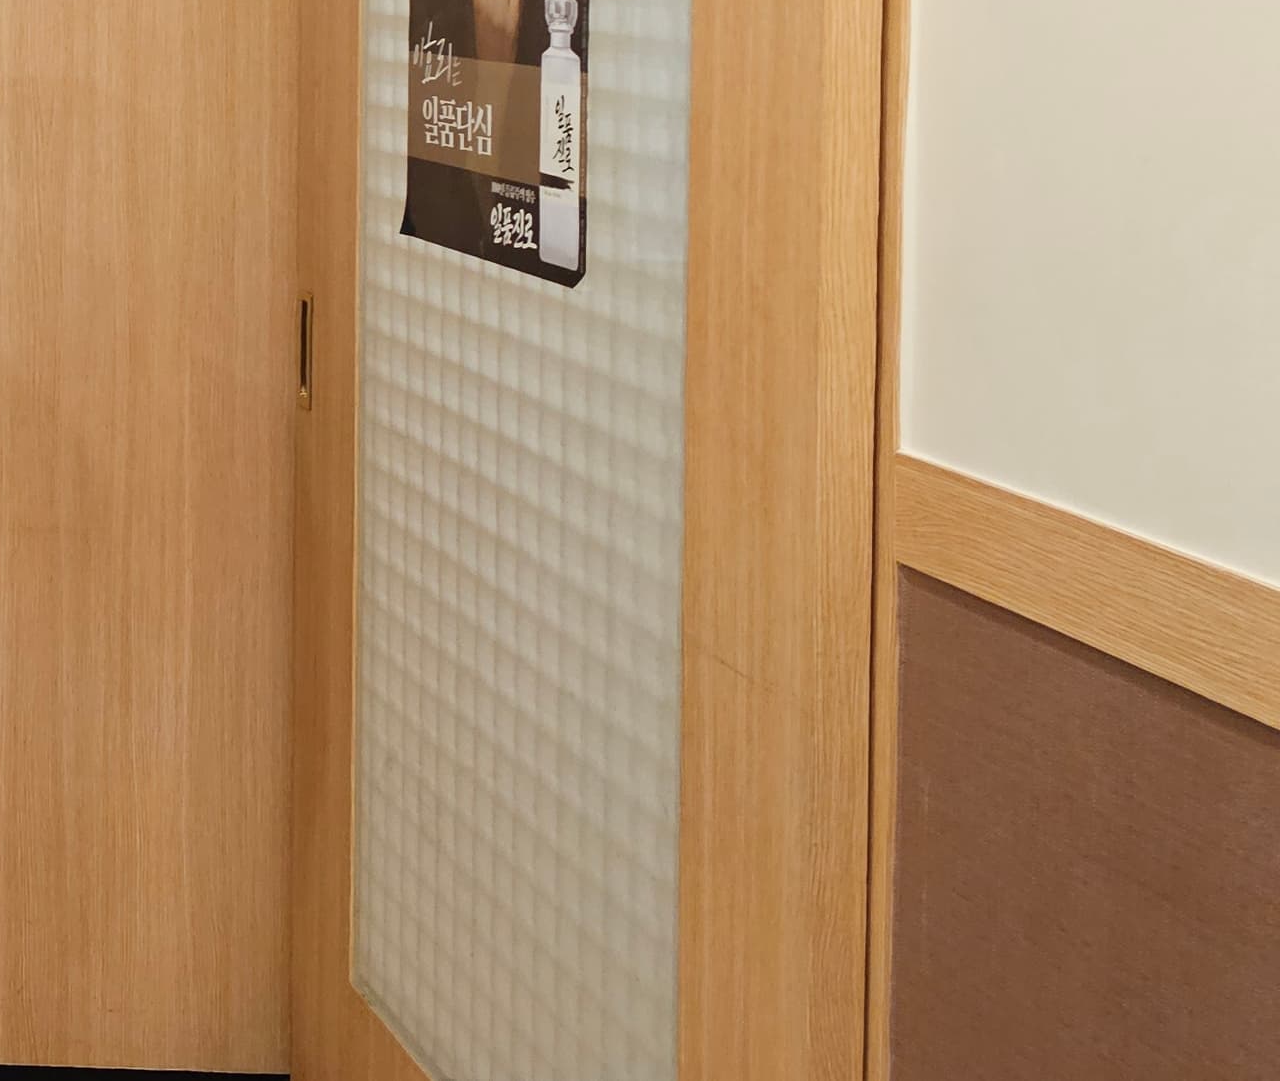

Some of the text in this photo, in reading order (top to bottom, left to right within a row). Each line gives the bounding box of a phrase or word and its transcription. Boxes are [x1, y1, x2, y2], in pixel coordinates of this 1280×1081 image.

[422, 95, 493, 156] 일품단심
[552, 94, 575, 173] 일품진로
[490, 203, 538, 249] 일품진로
